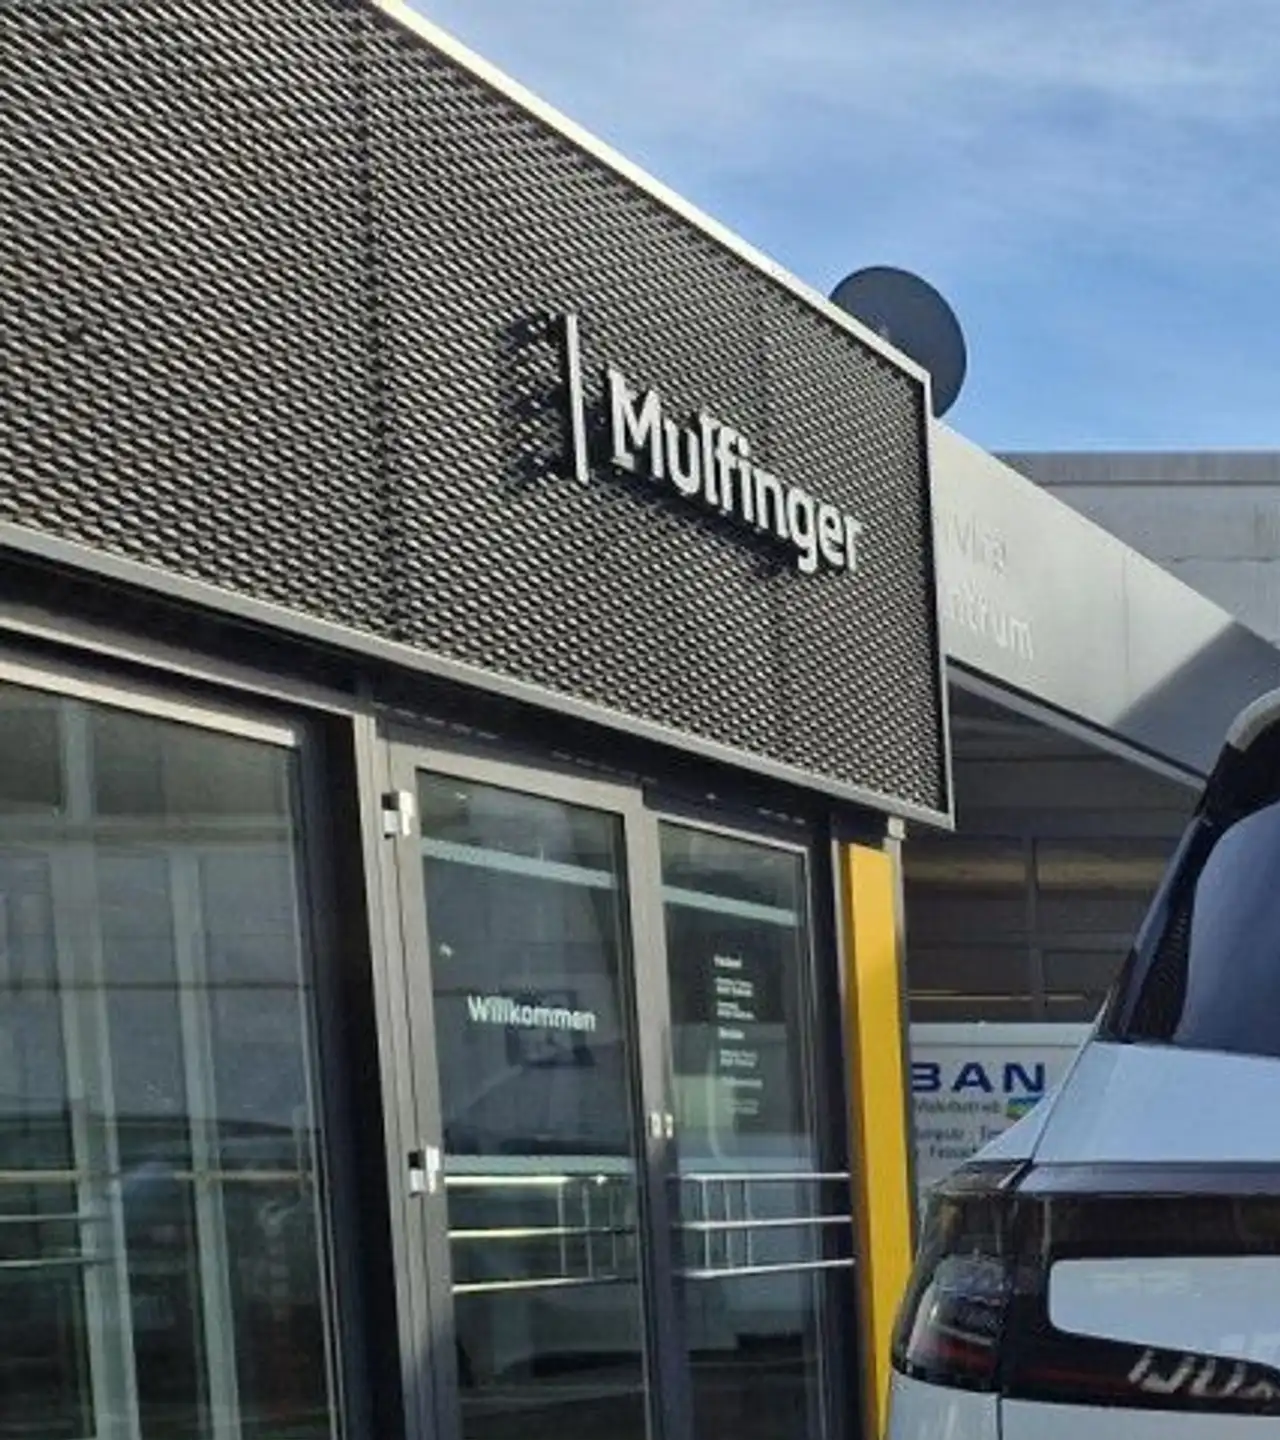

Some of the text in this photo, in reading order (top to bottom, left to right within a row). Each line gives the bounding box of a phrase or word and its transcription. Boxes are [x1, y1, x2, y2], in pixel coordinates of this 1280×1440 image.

[609, 368, 863, 574] Mulfinger
[467, 993, 597, 1032] Willkommen
[911, 1061, 1046, 1094] BAN
